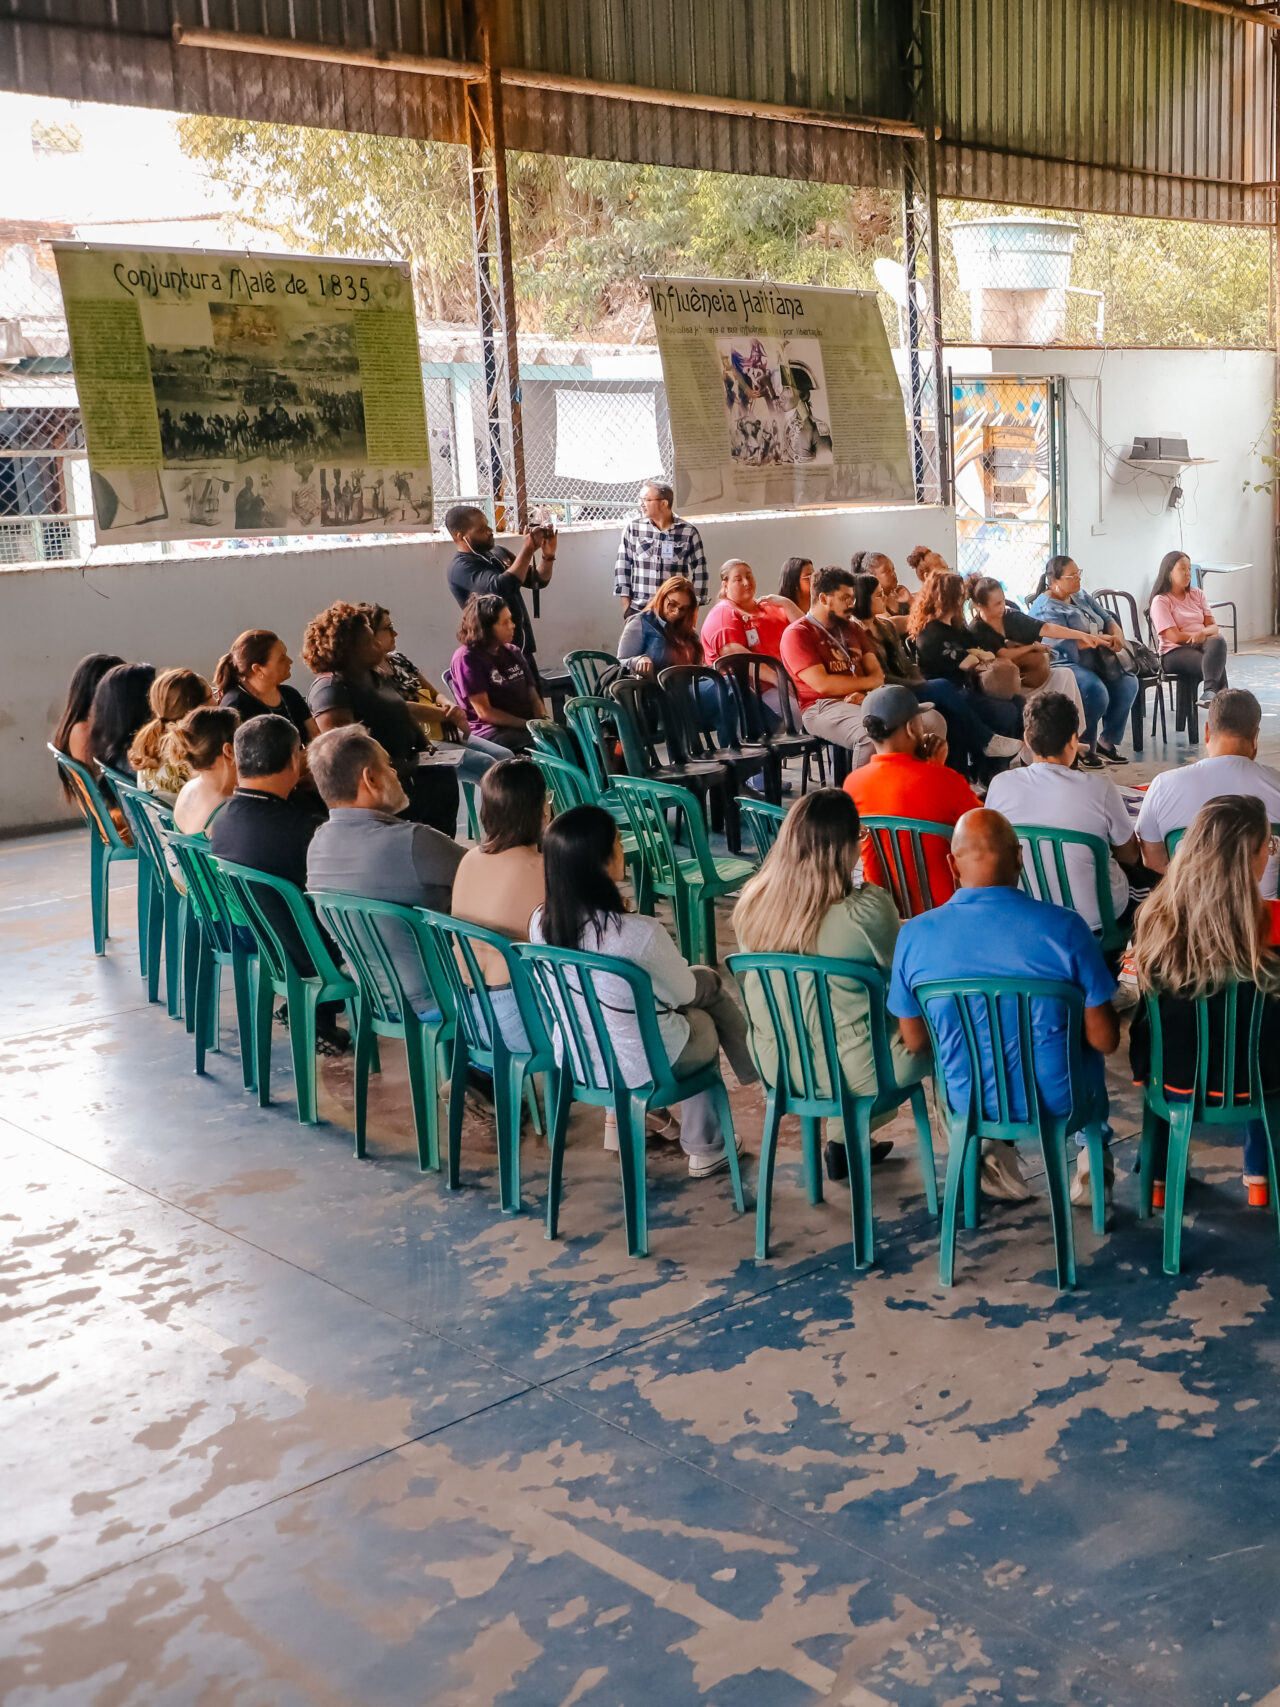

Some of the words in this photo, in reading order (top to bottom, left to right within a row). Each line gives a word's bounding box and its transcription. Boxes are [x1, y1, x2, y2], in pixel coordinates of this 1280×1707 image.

[113, 263, 222, 297] Conjuntura
[229, 268, 276, 301] Malê
[285, 273, 308, 295] de
[318, 273, 370, 302] 1835
[650, 285, 738, 323] Influência
[739, 289, 804, 322] Haitiana
